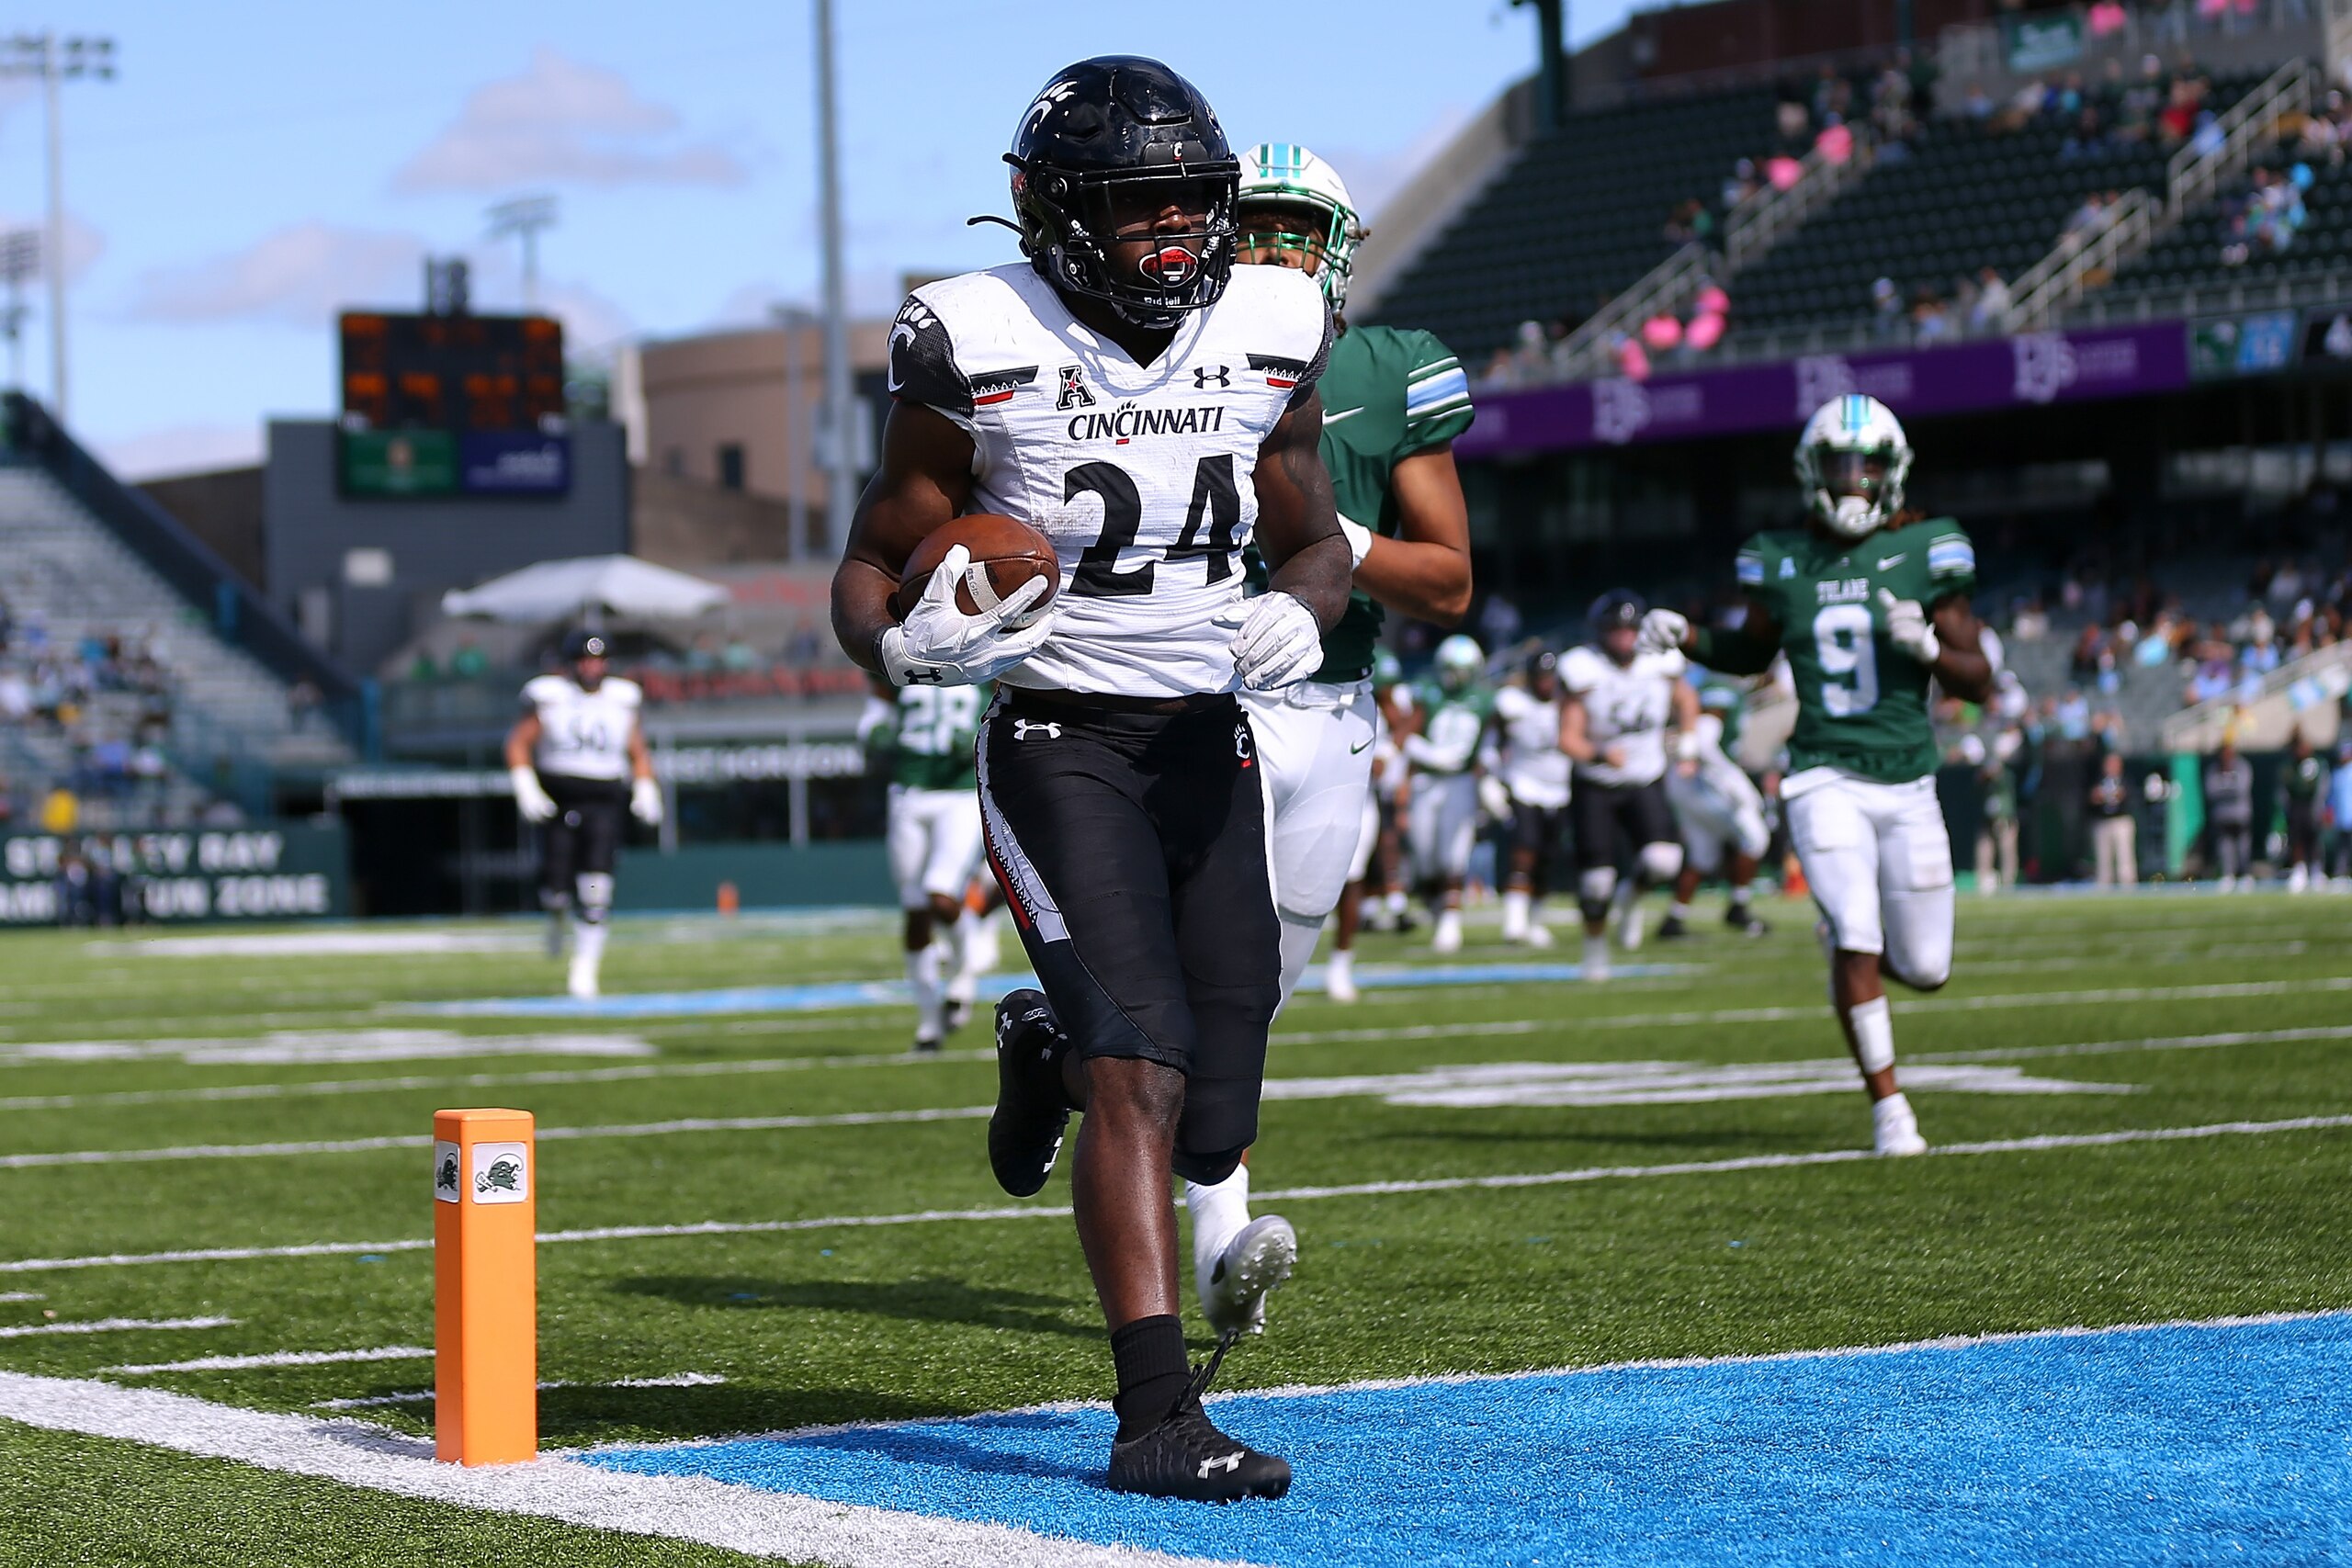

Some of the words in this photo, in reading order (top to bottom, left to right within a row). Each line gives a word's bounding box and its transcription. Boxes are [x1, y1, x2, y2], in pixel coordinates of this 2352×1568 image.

[1057, 365, 1096, 412] A
[1068, 404, 1225, 441] CINCINNATI
[1064, 454, 1242, 596] 24
[1815, 577, 1871, 604] TULANE
[1813, 603, 1878, 717] 9
[5, 834, 191, 877] STLEY
[198, 830, 286, 873] RAY
[214, 872, 331, 916] ZONE
